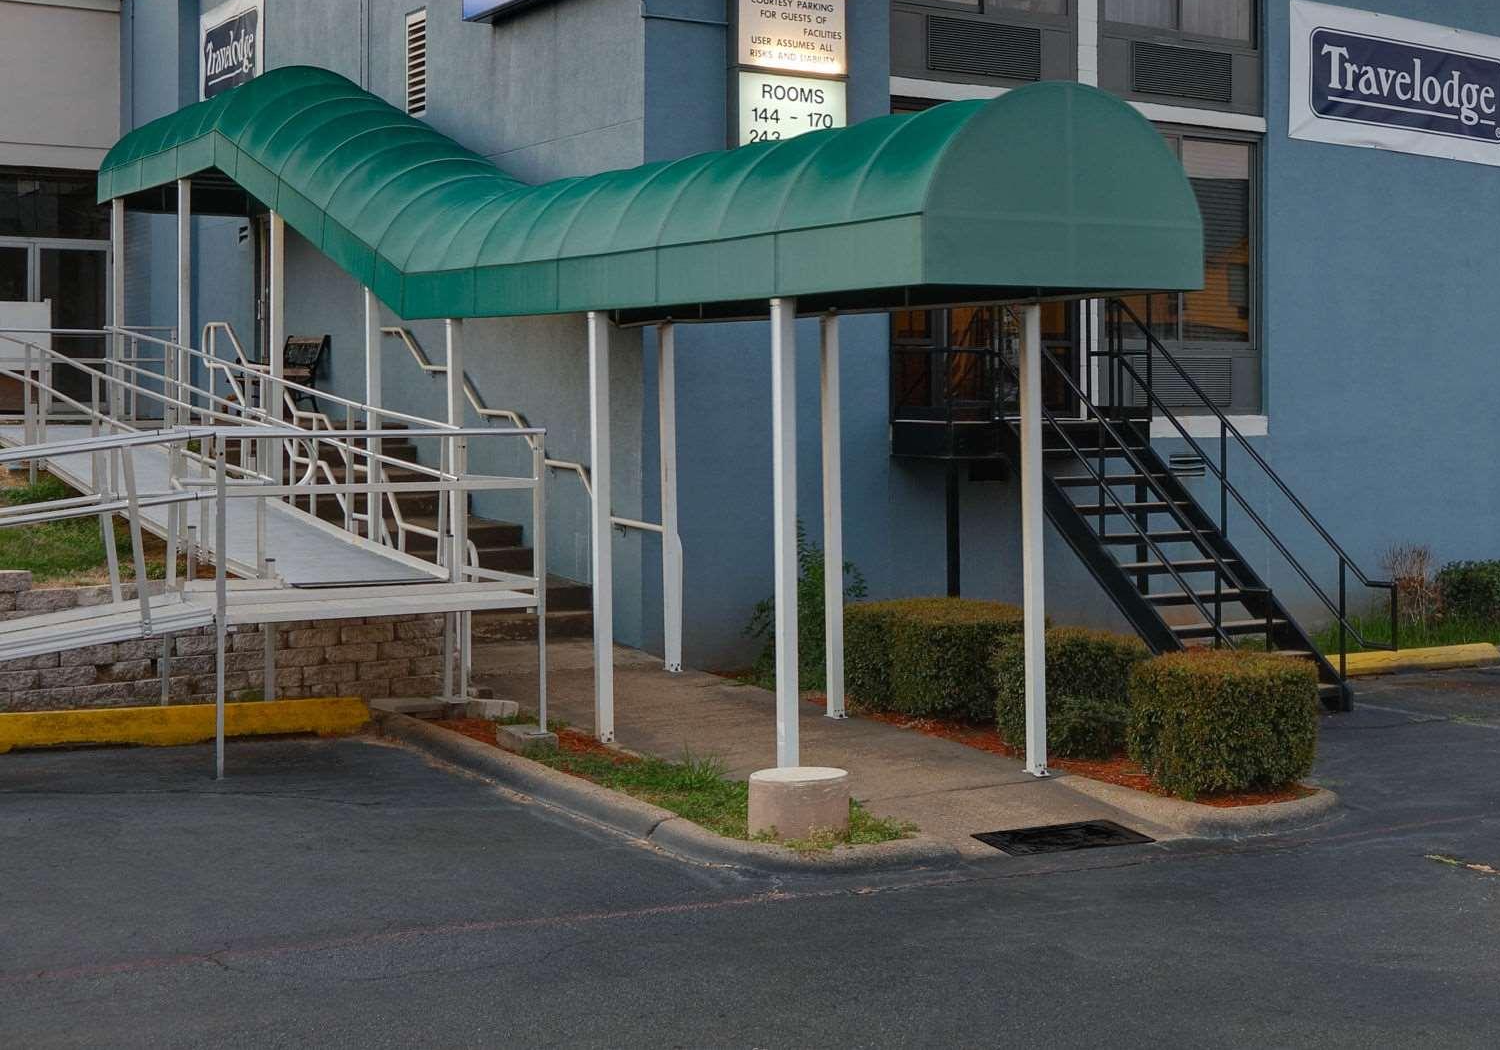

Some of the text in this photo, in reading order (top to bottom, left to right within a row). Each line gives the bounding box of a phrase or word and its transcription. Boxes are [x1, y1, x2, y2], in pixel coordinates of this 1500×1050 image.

[797, 0, 834, 12] PARKING
[760, 9, 828, 25] FOR GUESTS OF
[751, 35, 833, 52] USER ASSUMES ALL
[803, 28, 842, 40] FACILITIES
[206, 29, 254, 76] Travelodge
[762, 83, 825, 104] ROOMS
[1321, 44, 1496, 126] Travelodge
[751, 107, 780, 124] 144
[808, 112, 833, 129] 170
